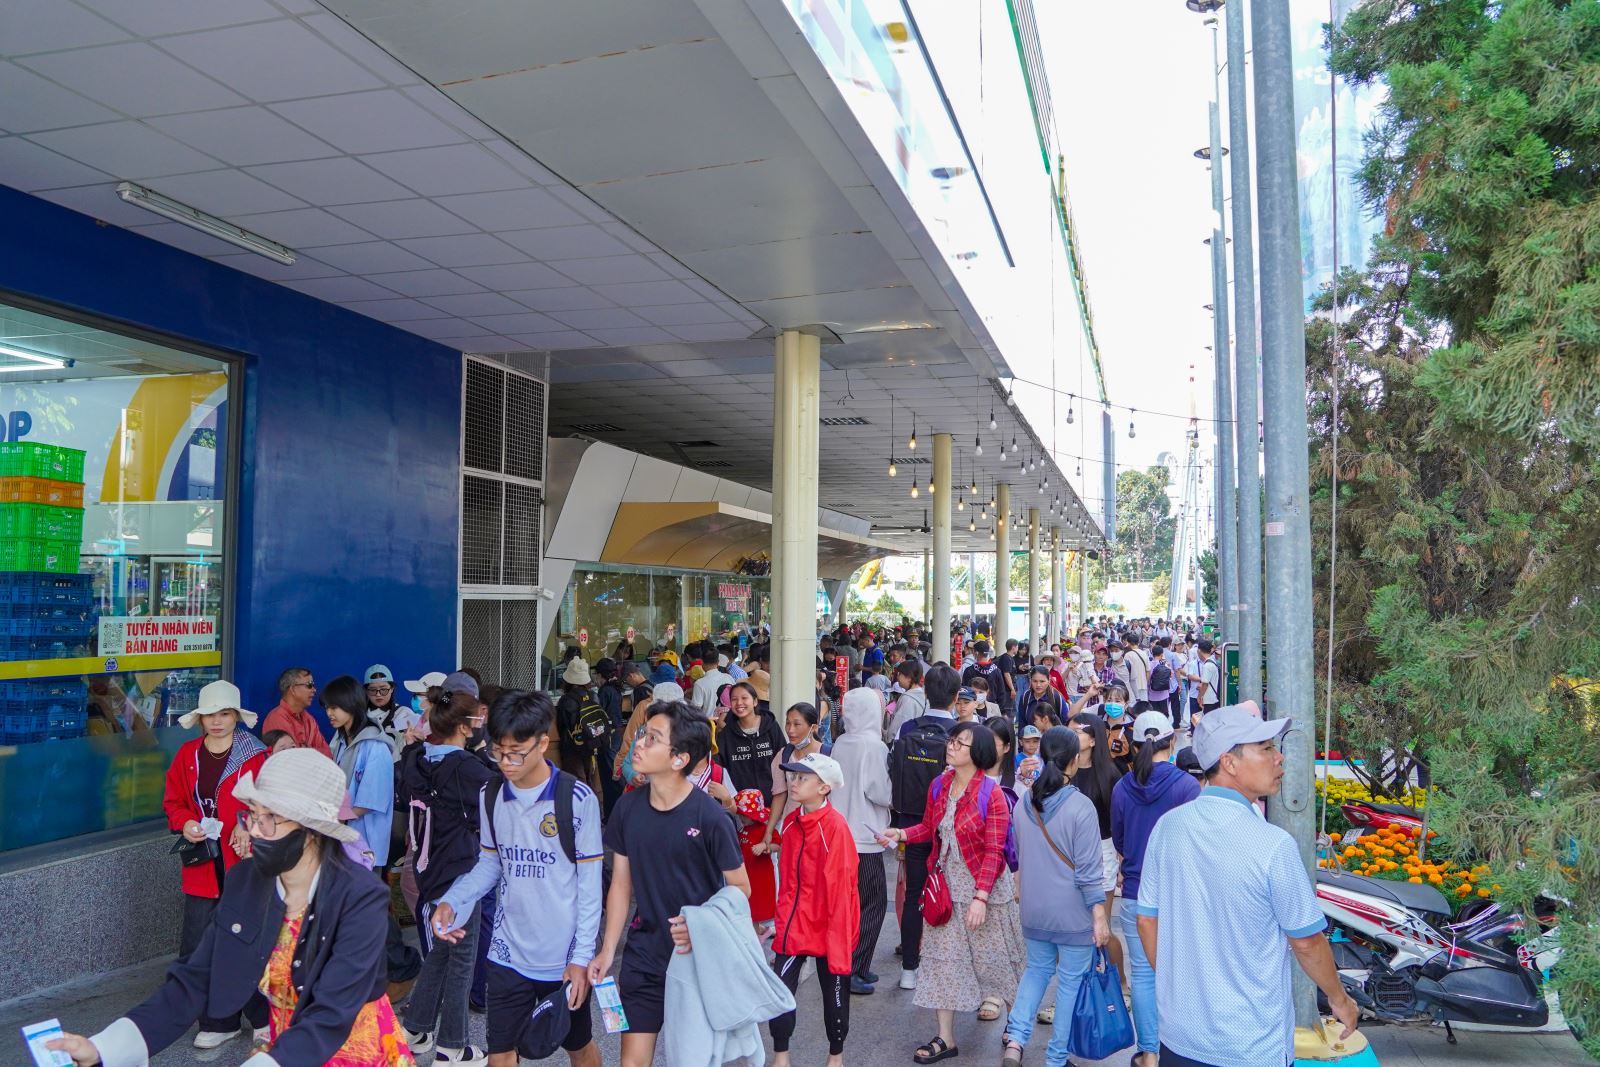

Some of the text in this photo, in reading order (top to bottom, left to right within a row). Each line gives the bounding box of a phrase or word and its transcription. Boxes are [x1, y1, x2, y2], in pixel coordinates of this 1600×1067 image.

[127, 618, 213, 636] TUYỂN NHÂN VIÊN
[126, 636, 178, 654] BÁN HÀNG
